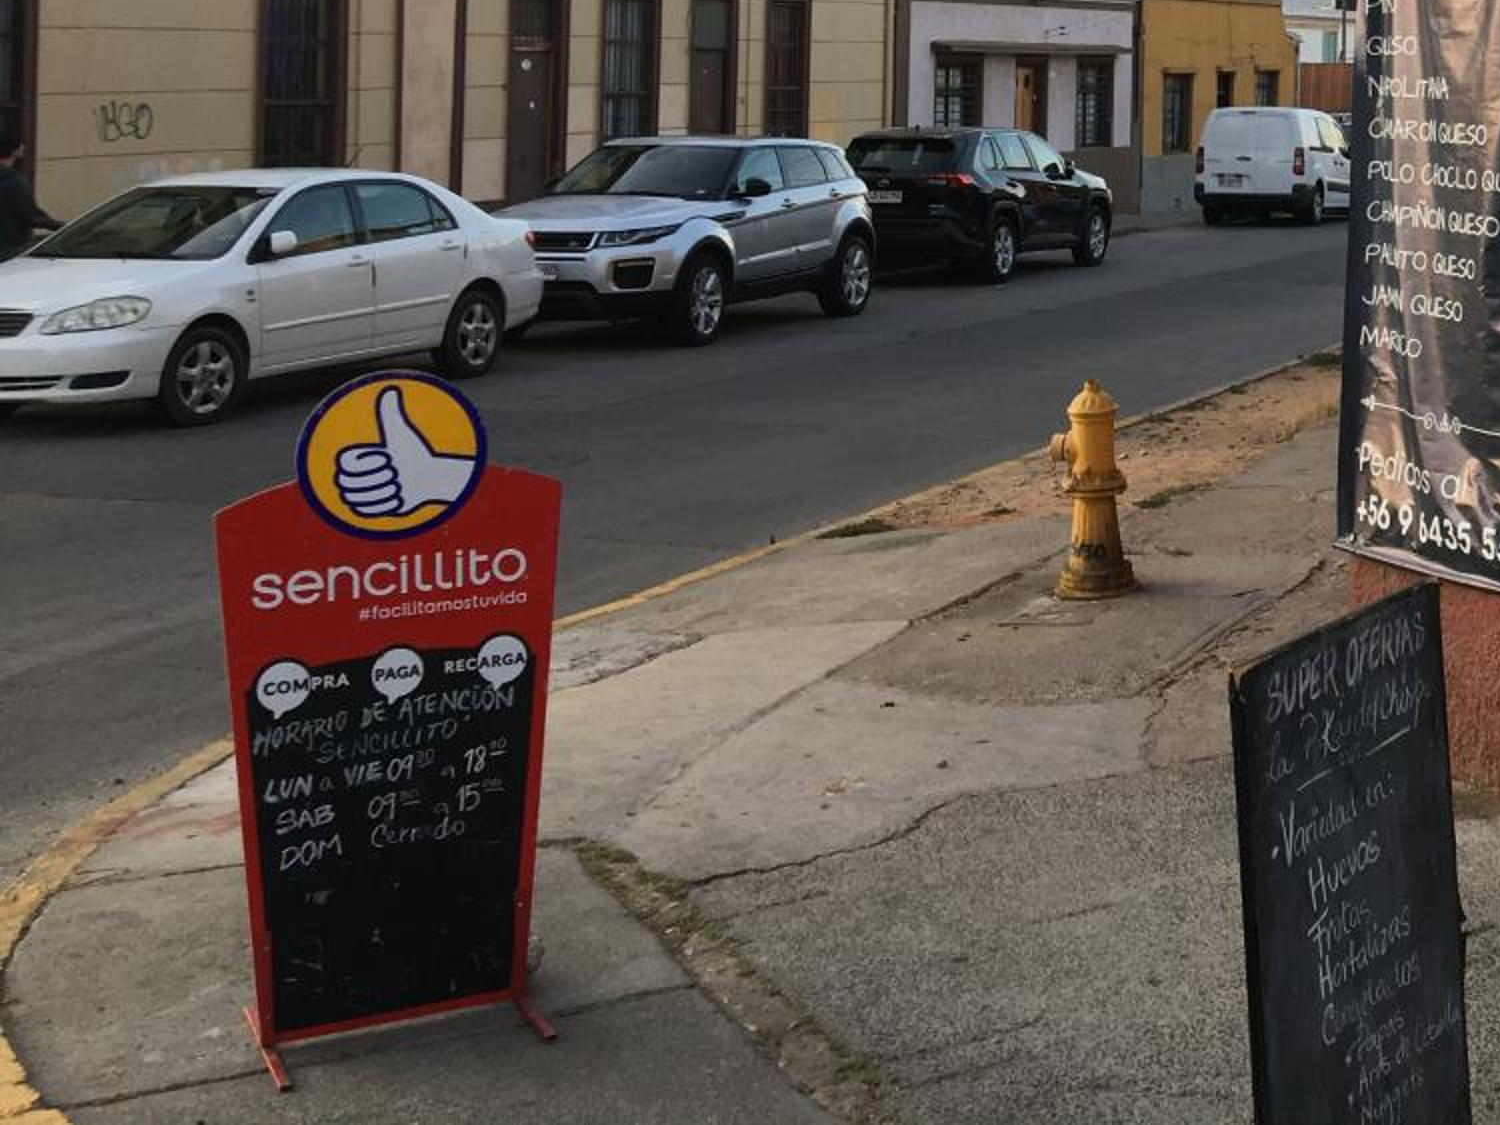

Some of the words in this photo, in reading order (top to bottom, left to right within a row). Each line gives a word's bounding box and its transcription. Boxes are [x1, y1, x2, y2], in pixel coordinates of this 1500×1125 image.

[1438, 123, 1488, 146] QUESO
[1447, 211, 1500, 238] QUESO
[1432, 252, 1476, 280] QUESO
[1410, 293, 1463, 323] QUESO
[1356, 494, 1391, 530] +56
[1398, 503, 1414, 536] 9
[1418, 511, 1471, 555] 6435
[252, 547, 528, 610] sencillito
[359, 590, 528, 621] #facilitamostuvida
[263, 672, 350, 697] COMPRA
[374, 664, 421, 682] PAGA
[444, 651, 527, 675] RECARGA
[1265, 646, 1340, 723] SUPER
[252, 711, 349, 758] HORARIO
[362, 701, 387, 728] DE
[264, 775, 313, 803] LUN
[343, 760, 384, 787] VIE
[275, 804, 336, 835] SAB
[280, 833, 344, 871] DOM
[370, 817, 466, 848] Cerrdo
